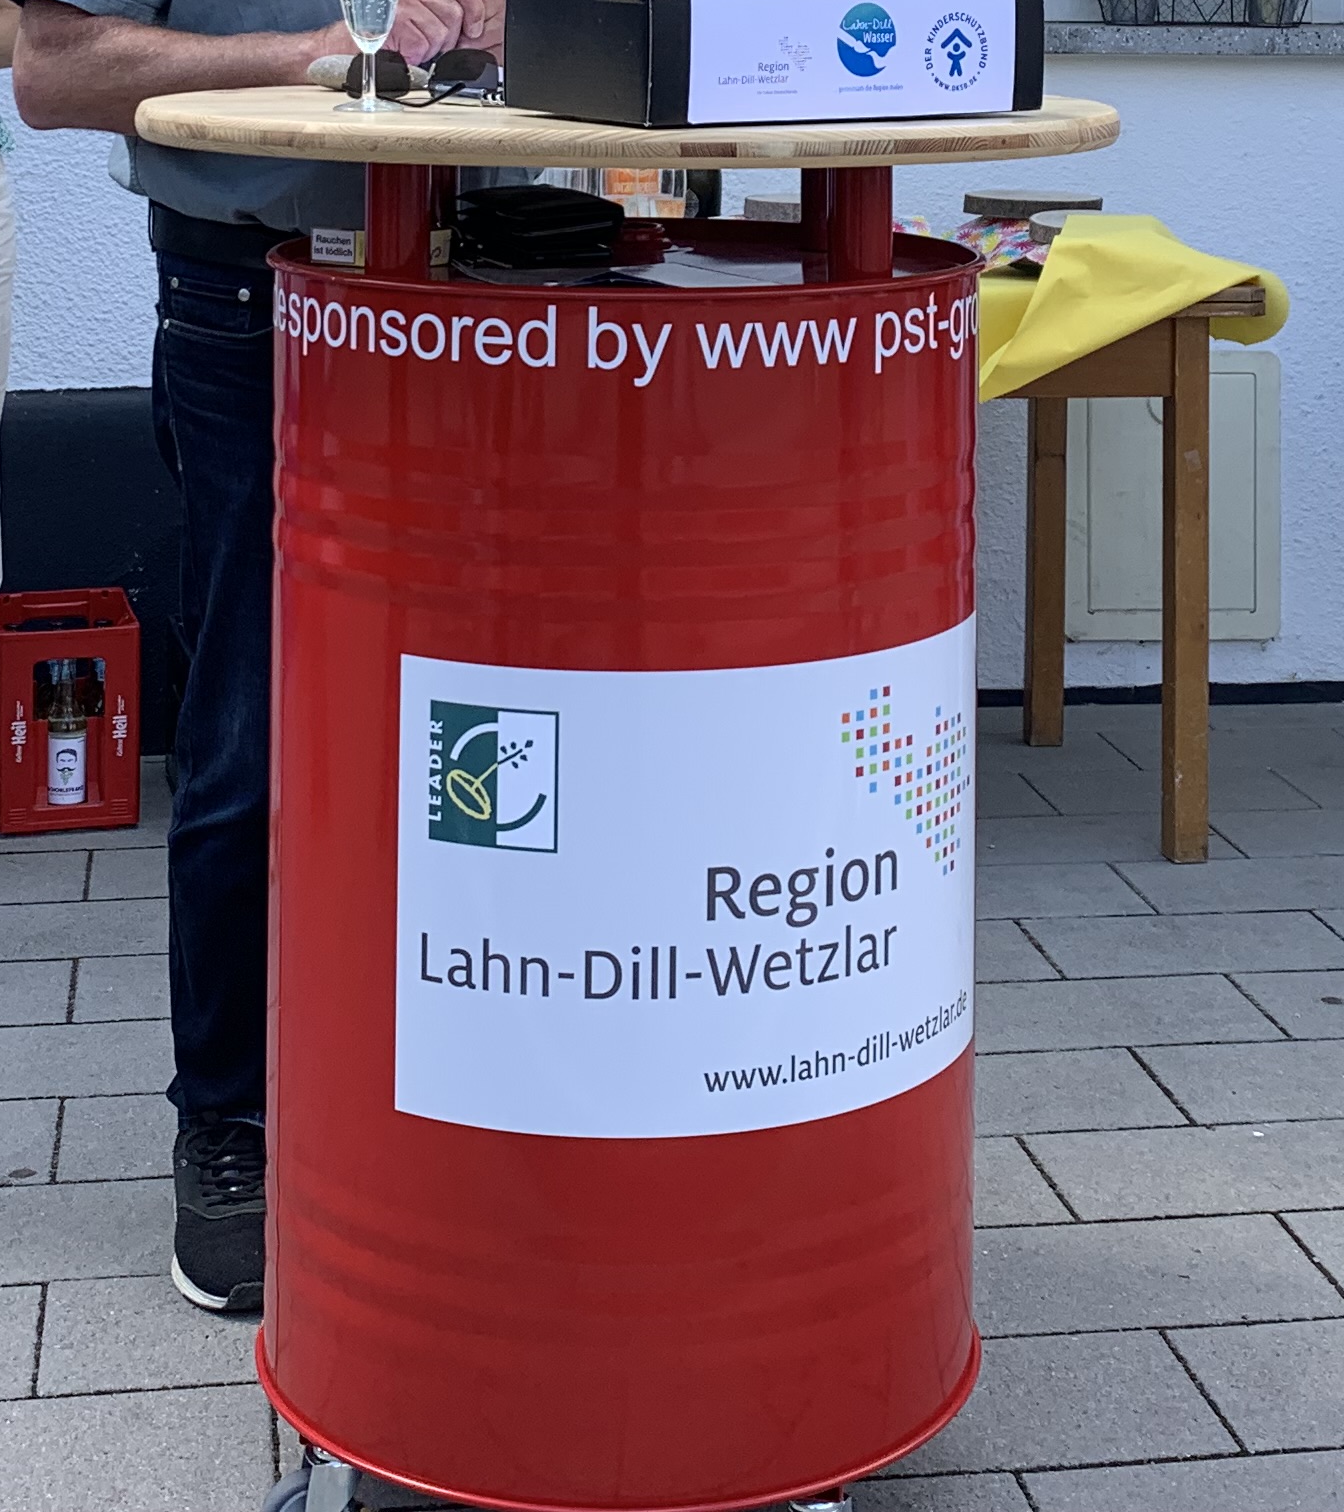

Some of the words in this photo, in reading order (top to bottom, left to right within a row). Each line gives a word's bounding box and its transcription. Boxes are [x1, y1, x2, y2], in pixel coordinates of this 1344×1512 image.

[863, 31, 894, 44] Wasser
[927, 11, 989, 69] KINDERSCHUTZBUND
[758, 61, 790, 74] Region
[924, 47, 935, 70] DER
[718, 74, 789, 86] Lahn-Dill-Wetzlar
[313, 247, 324, 255] ist
[315, 234, 352, 245] Rauchen
[587, 305, 672, 387] by
[695, 317, 857, 370] www
[11, 720, 27, 745] Heil
[111, 714, 127, 739] Heil
[427, 717, 443, 823] LEADER
[706, 847, 899, 928] Region
[420, 924, 898, 1002] Lahn-Dill-Wetzlar
[704, 988, 969, 1093] www.lahn-dill-wetzlar.de
